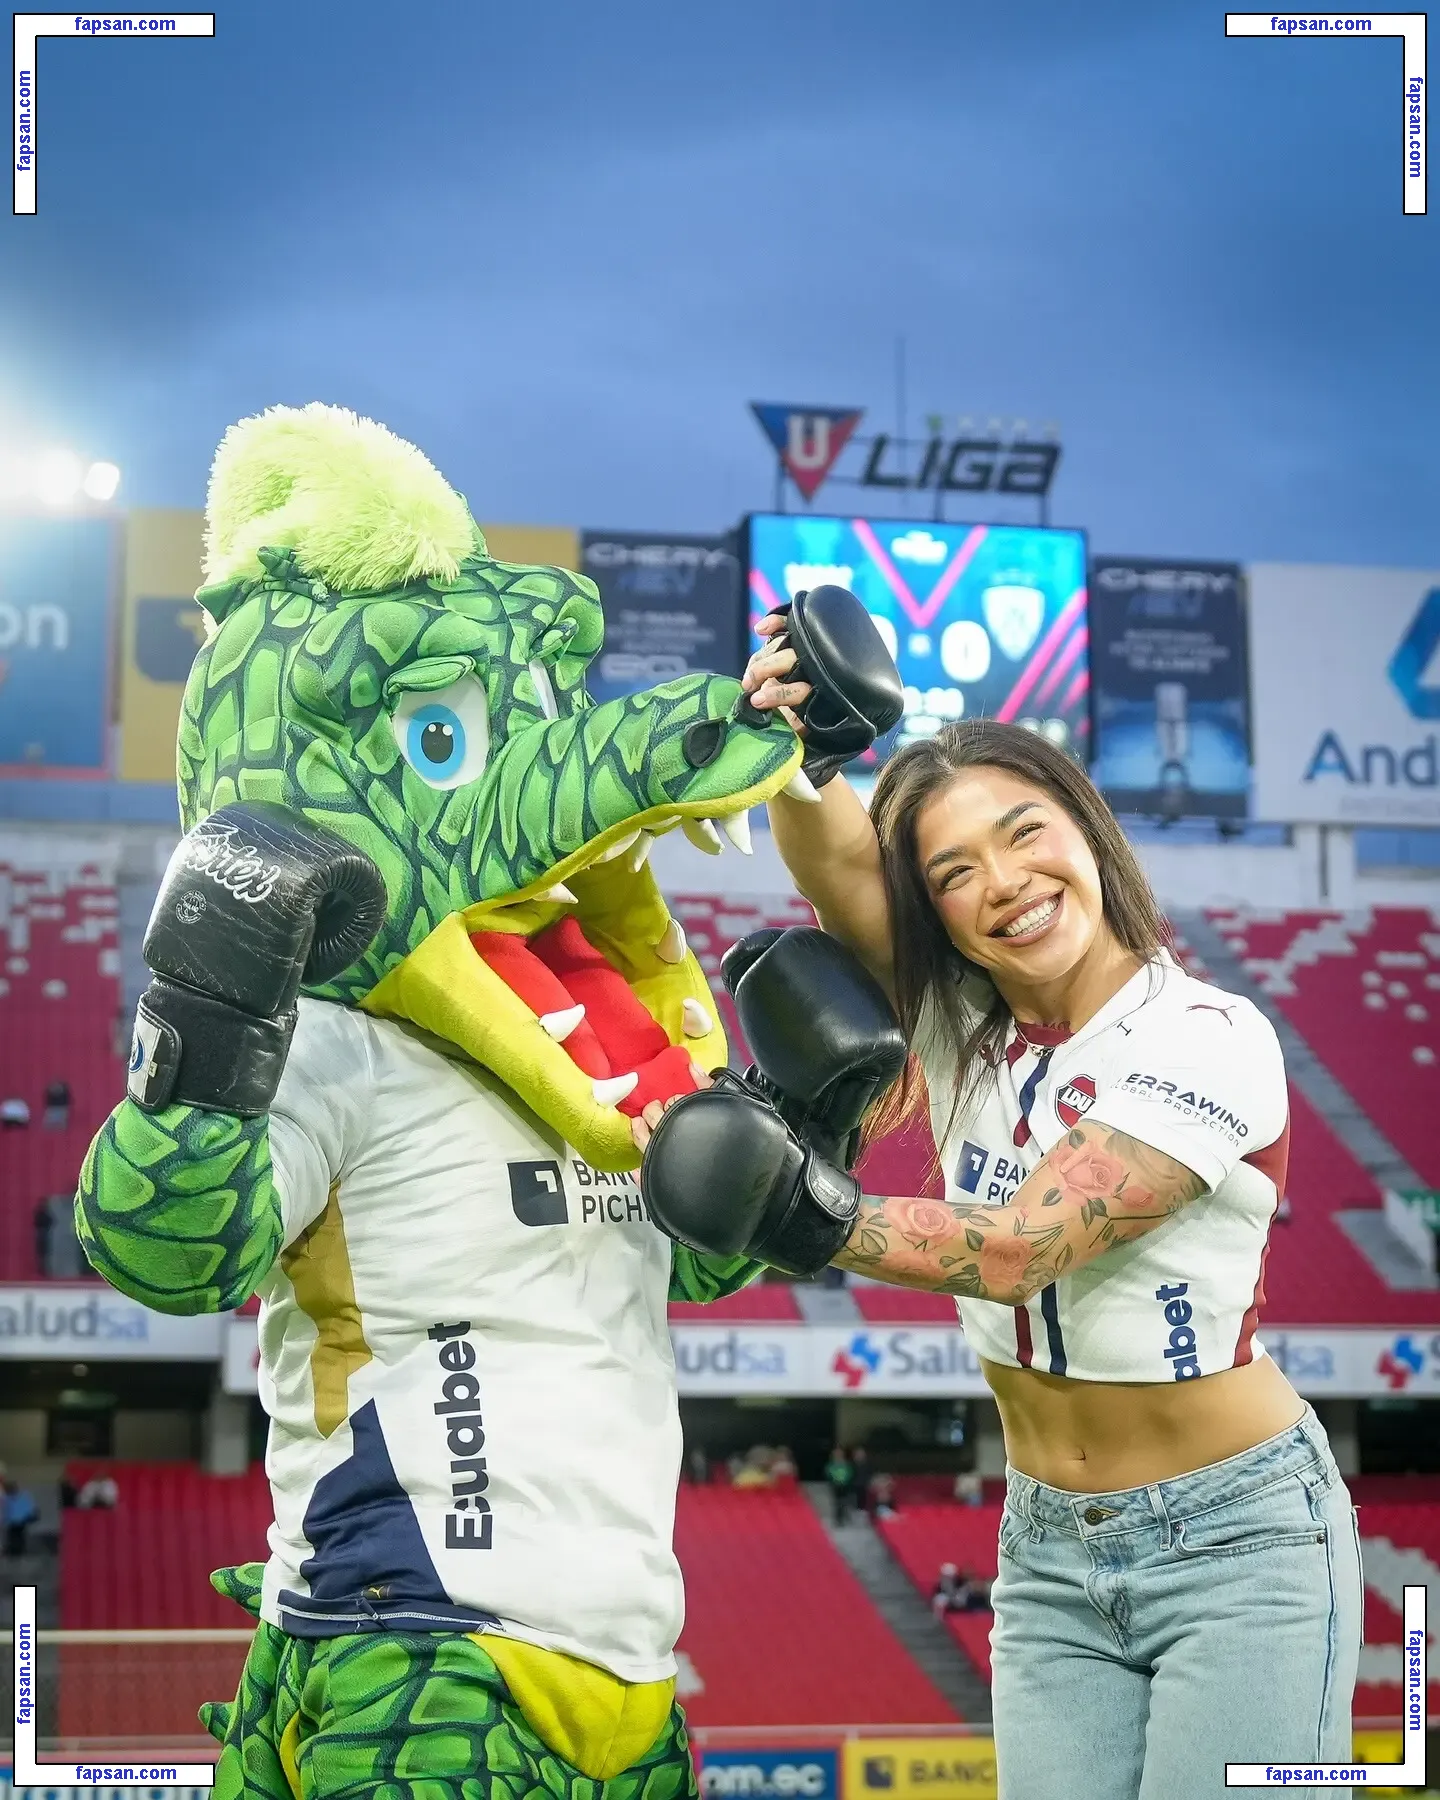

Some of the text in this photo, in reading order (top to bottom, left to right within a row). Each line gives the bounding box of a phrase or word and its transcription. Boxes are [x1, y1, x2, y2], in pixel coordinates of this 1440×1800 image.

[1060, 1087, 1093, 1112] LDU
[1116, 1072, 1249, 1138] ERRAWIND
[1163, 1096, 1241, 1148] PROTECTION
